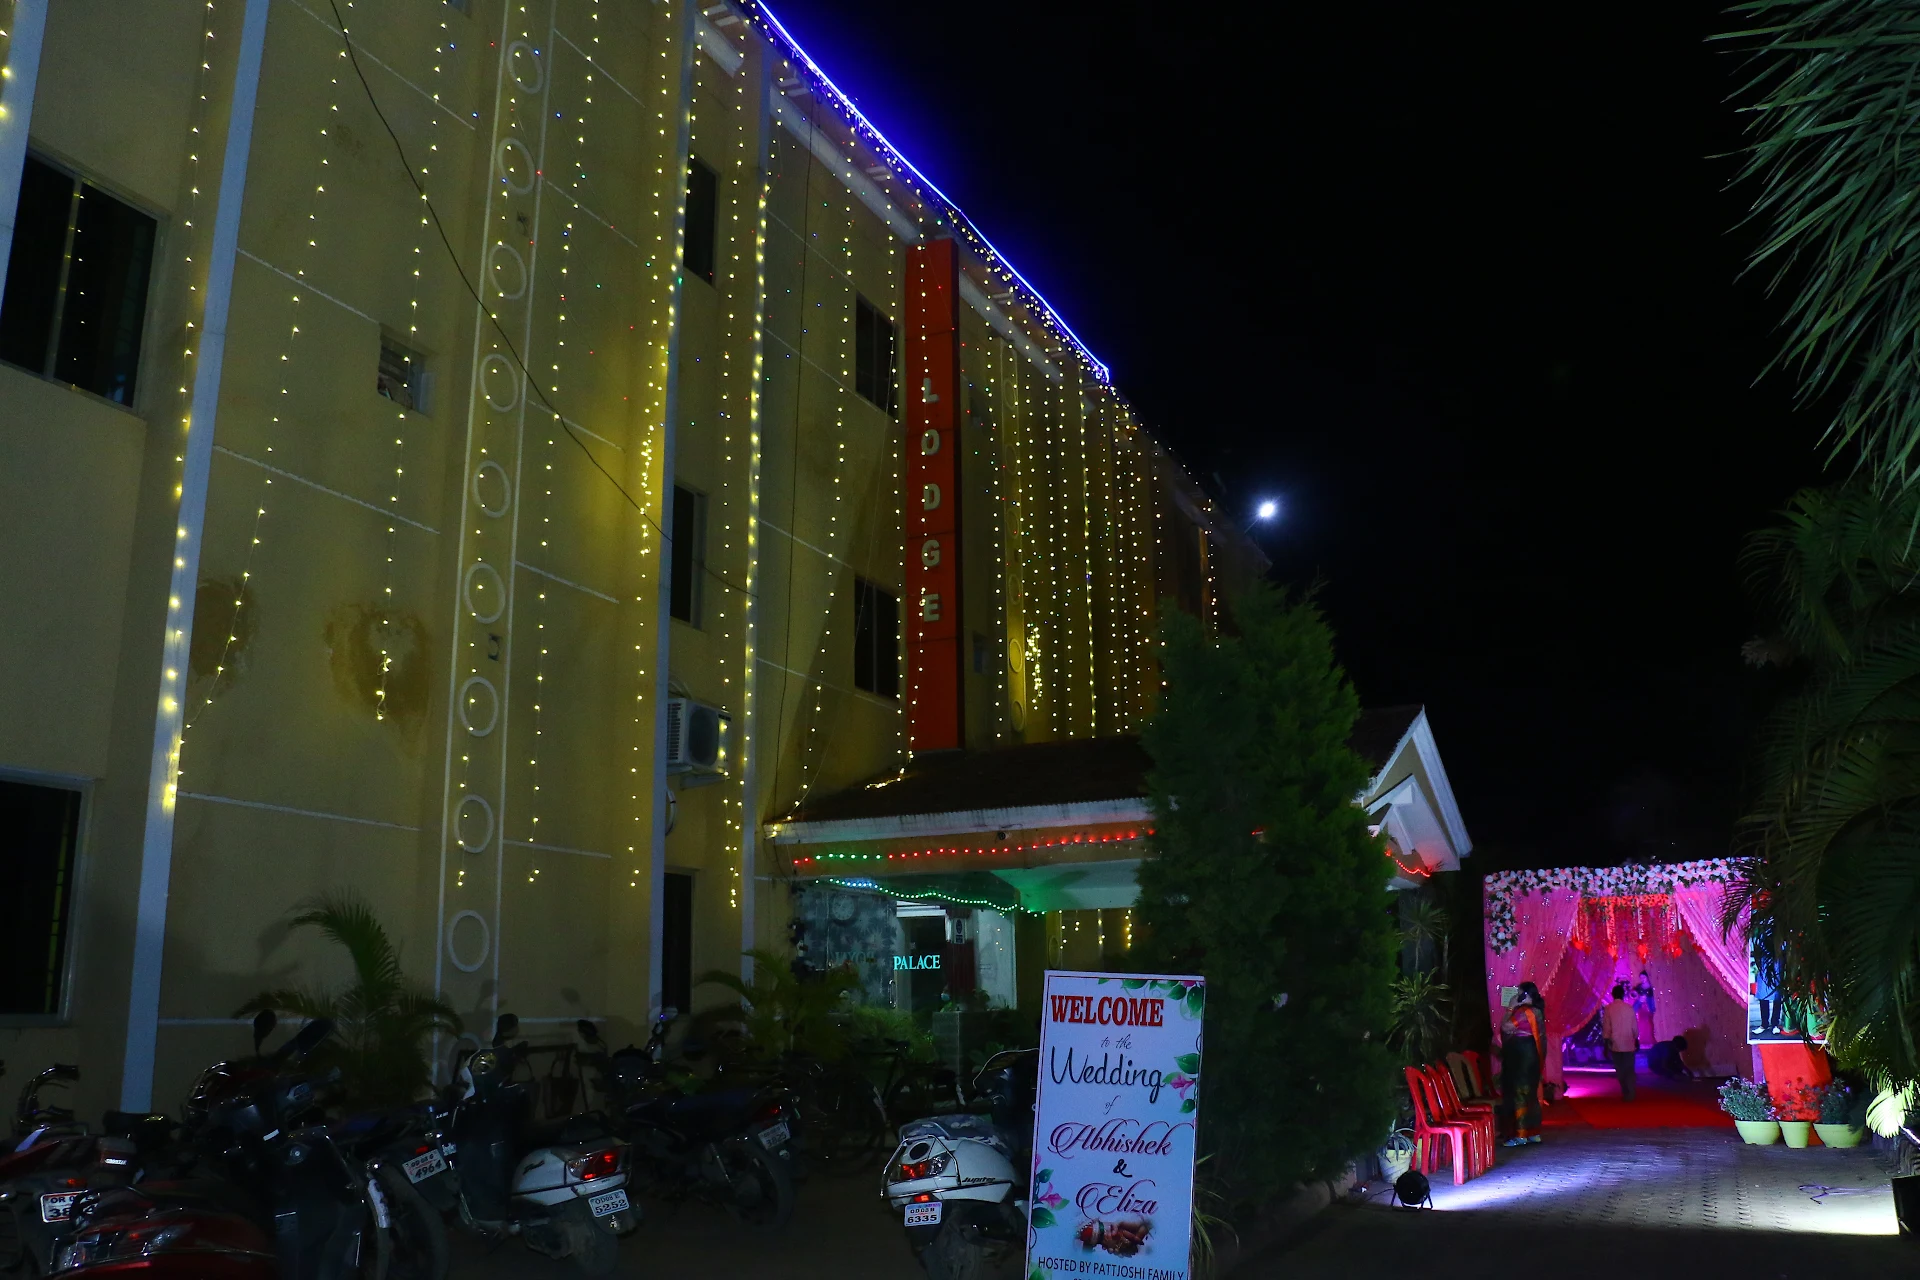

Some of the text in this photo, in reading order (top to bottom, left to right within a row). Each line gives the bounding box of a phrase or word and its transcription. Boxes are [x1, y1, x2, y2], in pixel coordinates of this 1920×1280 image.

[921, 376, 940, 622] LODGE
[893, 954, 941, 971] PALACE
[1050, 995, 1165, 1027] WELCOME
[1101, 1032, 1132, 1049] to the
[1050, 1045, 1167, 1104] Wedding
[1103, 1094, 1121, 1116] of
[1047, 1117, 1194, 1160] Abhishek
[415, 1160, 442, 1178] 4964
[1113, 1158, 1133, 1178] &
[962, 1176, 996, 1184] Jupiter
[51, 1196, 66, 1204] OR
[595, 1199, 627, 1213] 5252
[1075, 1178, 1159, 1220] Eliza
[907, 1214, 937, 1223] 6335
[1037, 1256, 1185, 1280] HOSTED BY PATTJOSHI FAMILY
